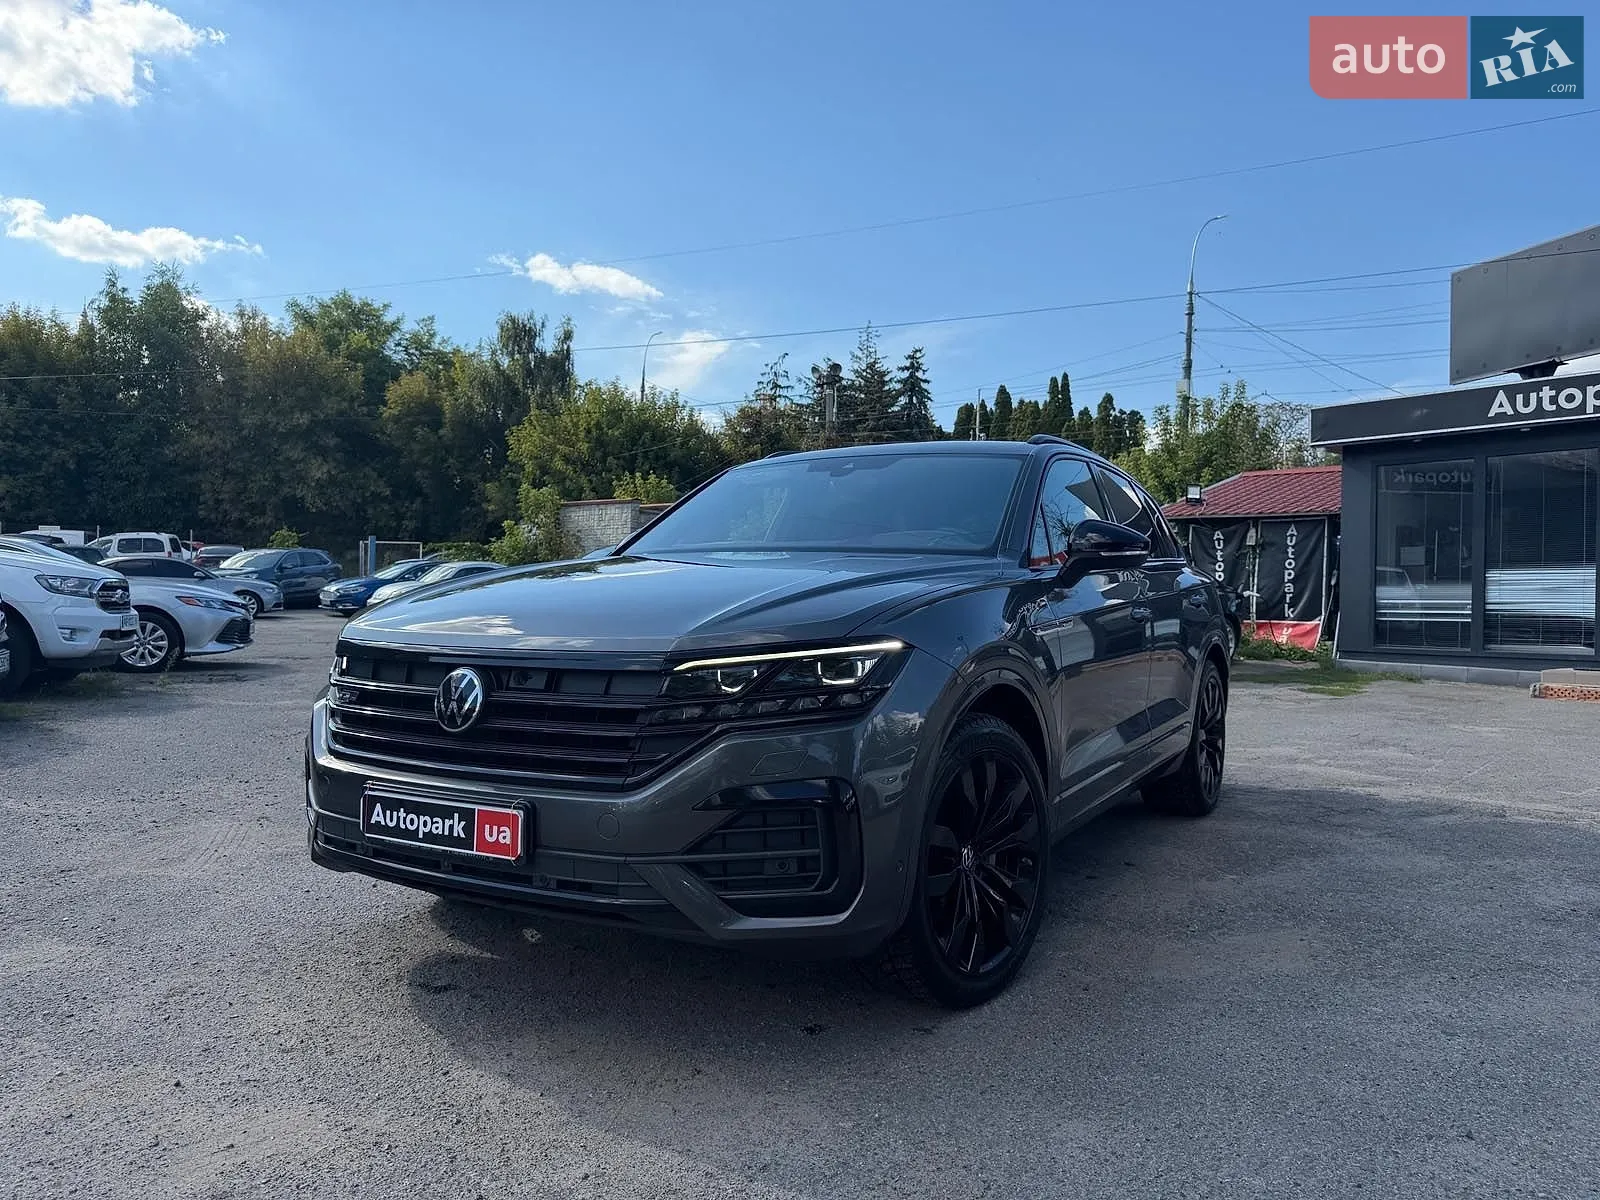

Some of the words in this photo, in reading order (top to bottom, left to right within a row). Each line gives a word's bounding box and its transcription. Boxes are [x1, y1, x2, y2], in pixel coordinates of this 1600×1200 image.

[1284, 523, 1298, 618] Autopark
[370, 802, 466, 839] Autopark
[484, 823, 512, 845] ua
